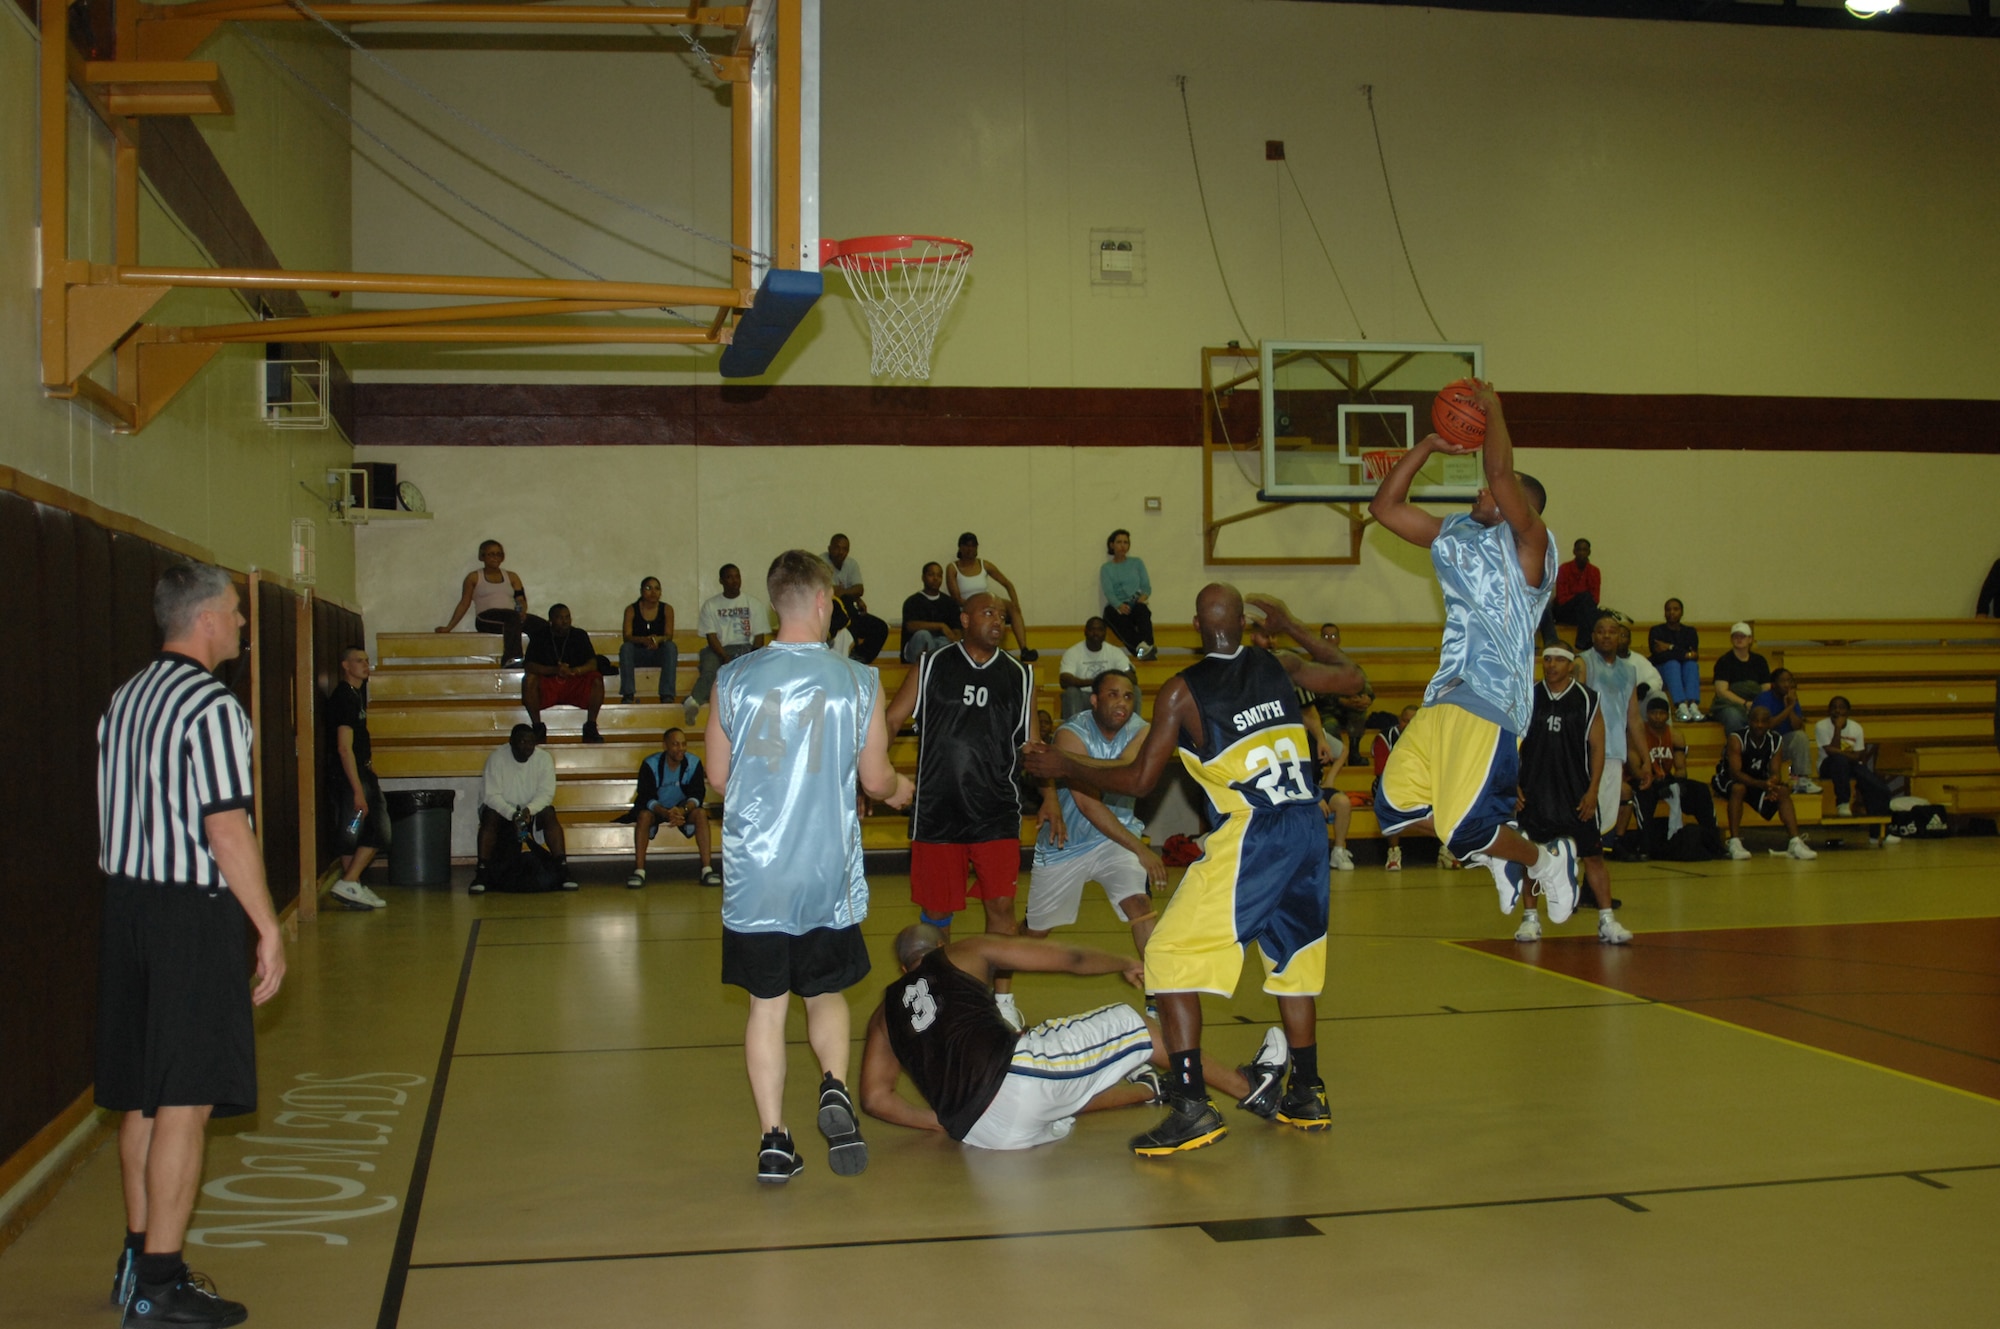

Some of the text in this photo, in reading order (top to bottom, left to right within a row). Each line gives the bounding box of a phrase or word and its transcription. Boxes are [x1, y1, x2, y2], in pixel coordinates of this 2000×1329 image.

[963, 684, 989, 708] 50
[1232, 700, 1285, 732] SMITH
[1546, 715, 1562, 733] 15
[744, 689, 826, 773] 41
[1245, 737, 1313, 806] 23
[902, 977, 938, 1033] 3
[185, 1072, 427, 1248] NOMADS
